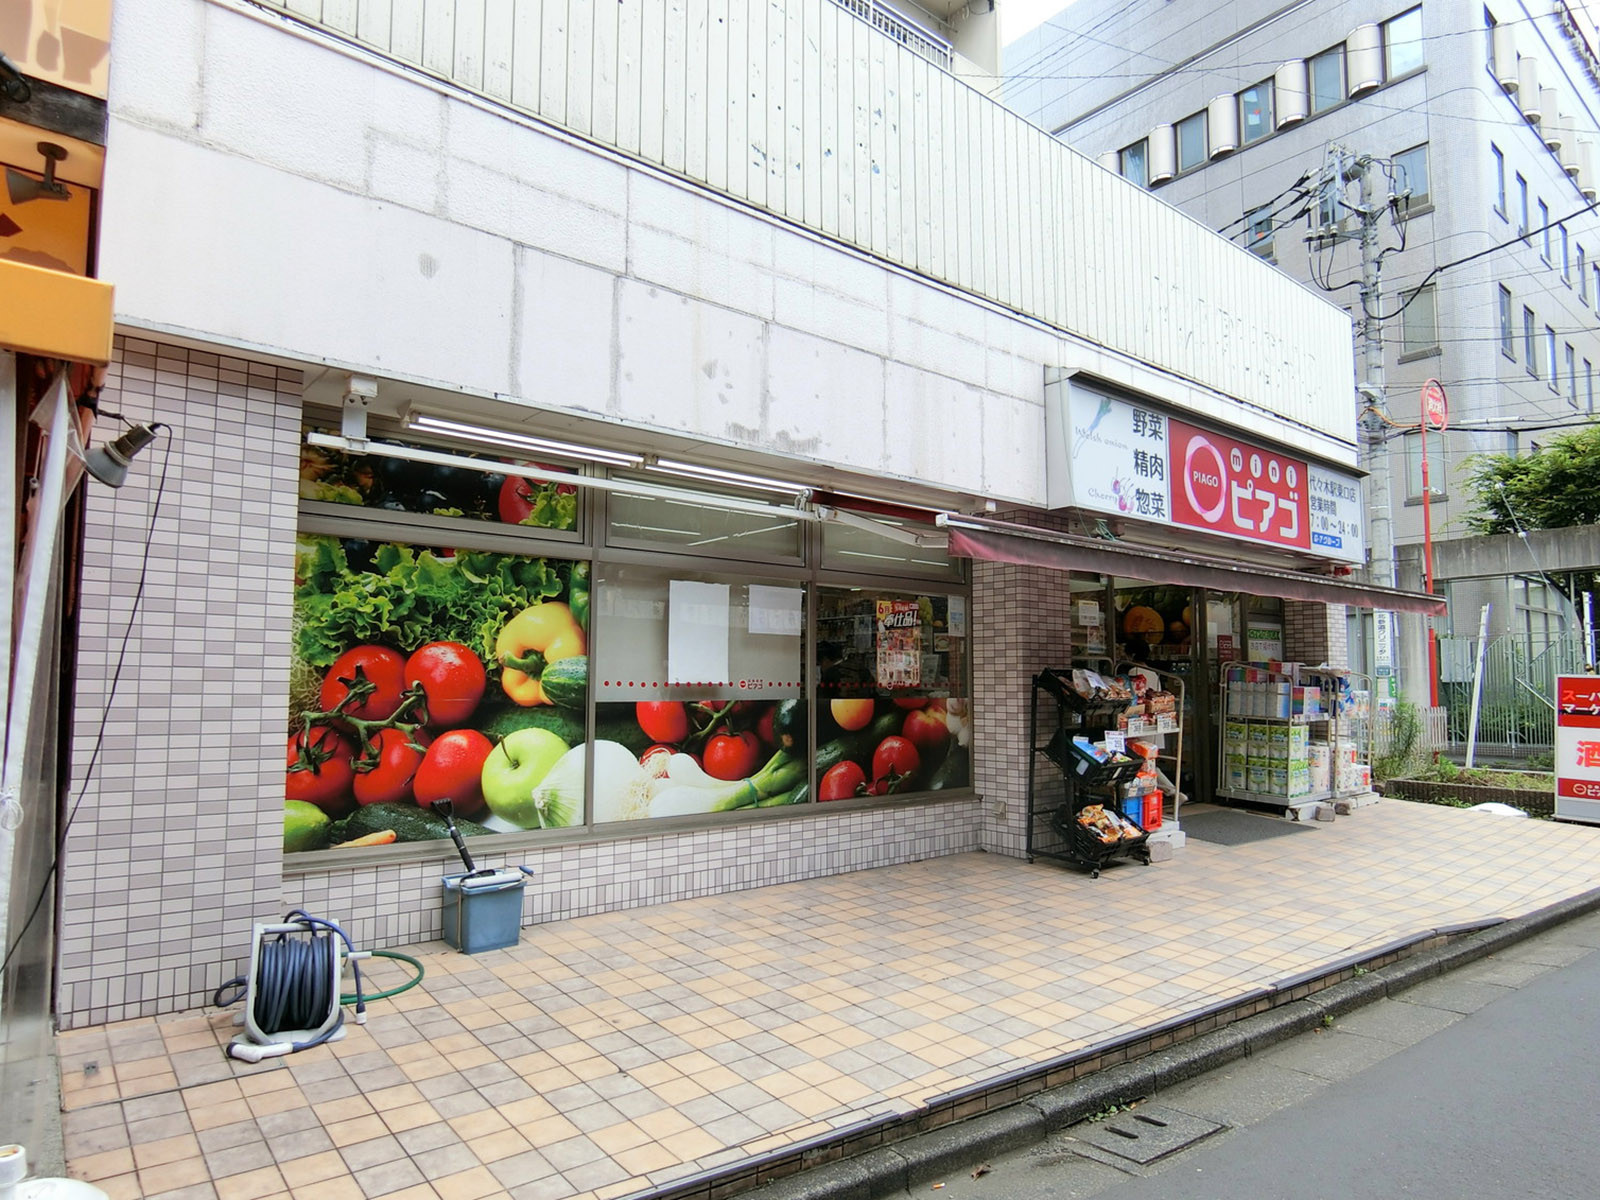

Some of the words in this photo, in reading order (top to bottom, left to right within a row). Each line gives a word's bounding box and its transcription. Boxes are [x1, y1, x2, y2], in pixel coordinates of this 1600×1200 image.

[1133, 408, 1163, 441] 野菜
[1133, 448, 1164, 481] 精肉
[1193, 470, 1219, 488] PIAGO
[1232, 453, 1293, 484] mini
[1135, 488, 1165, 518] 惣菜
[1231, 479, 1299, 539] ピアゴ
[1310, 495, 1337, 517] 営業時間
